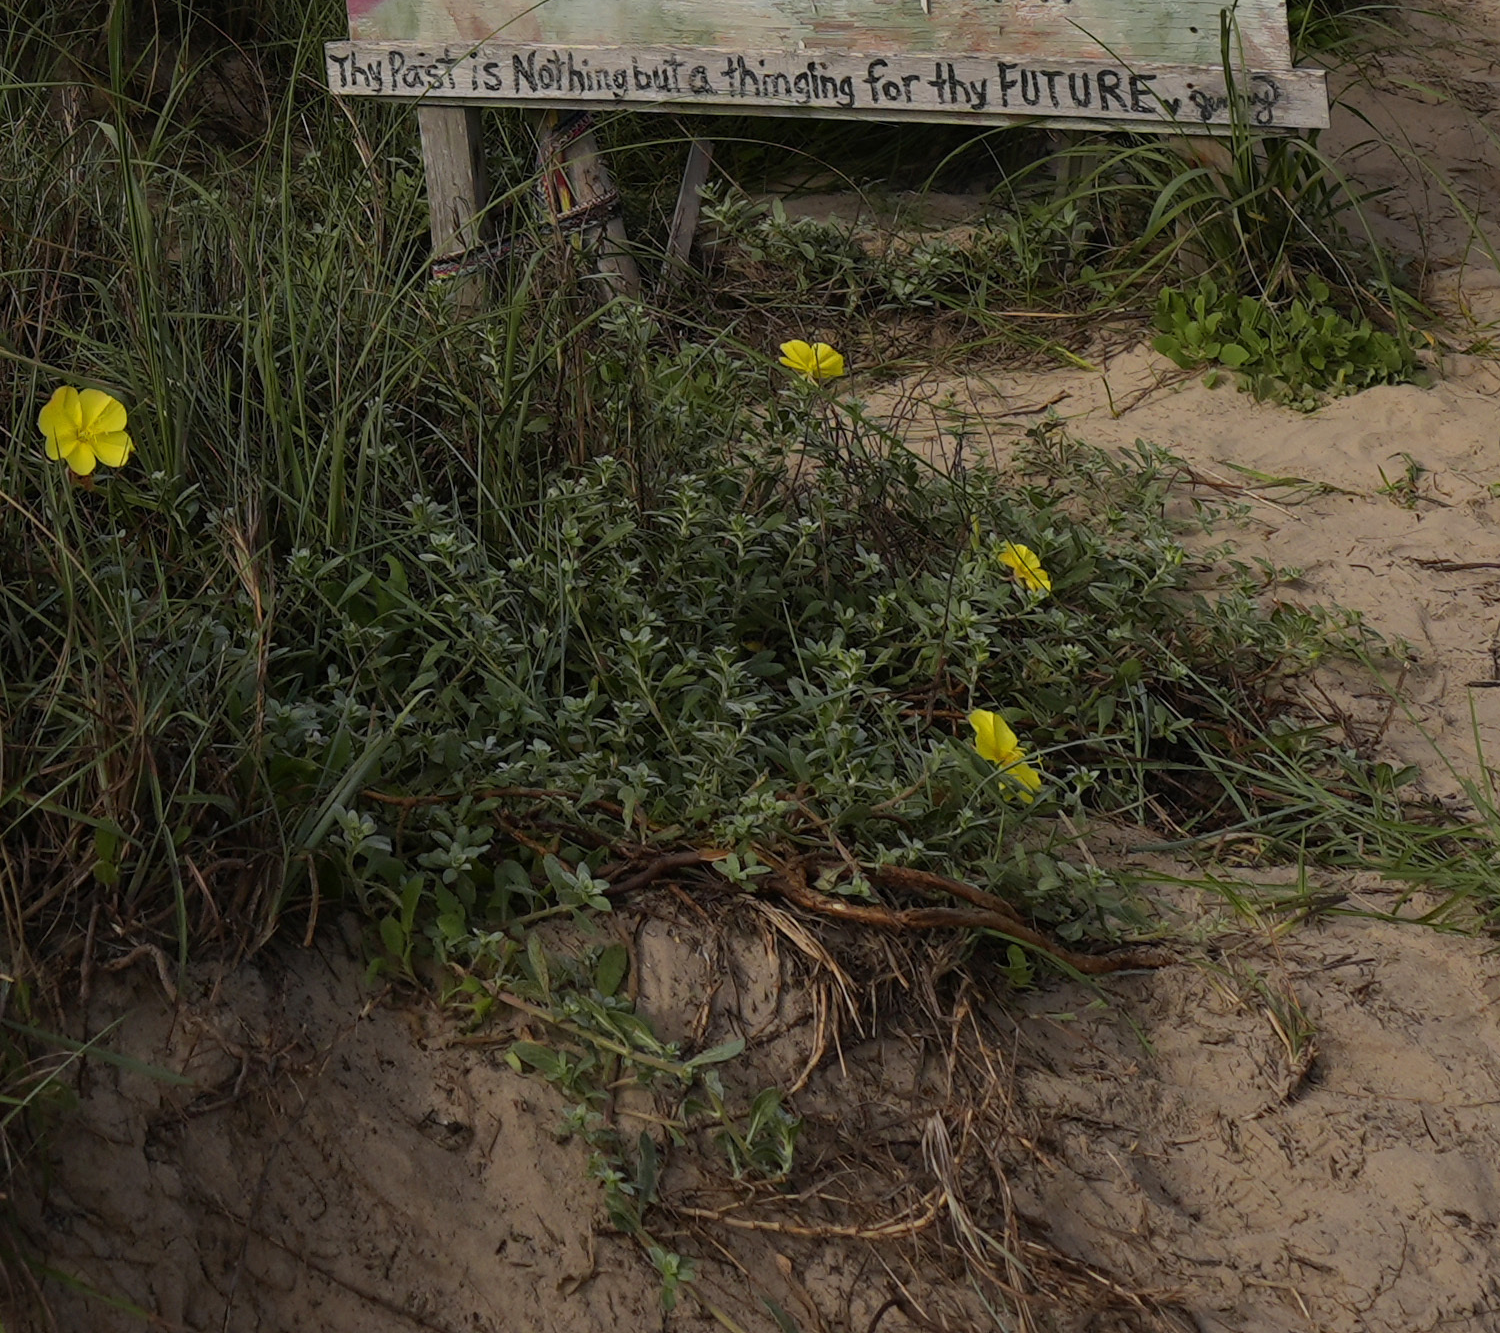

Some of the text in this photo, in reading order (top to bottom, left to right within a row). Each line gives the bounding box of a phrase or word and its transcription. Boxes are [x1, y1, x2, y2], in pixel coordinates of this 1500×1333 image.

[328, 49, 384, 94] Thy
[388, 47, 460, 92] Past
[470, 50, 503, 92] is
[512, 49, 629, 99] Nothing
[631, 52, 688, 94] but
[689, 65, 718, 95] a
[862, 58, 921, 104] for
[926, 62, 988, 111] thy
[997, 61, 1157, 114] FUTURE
